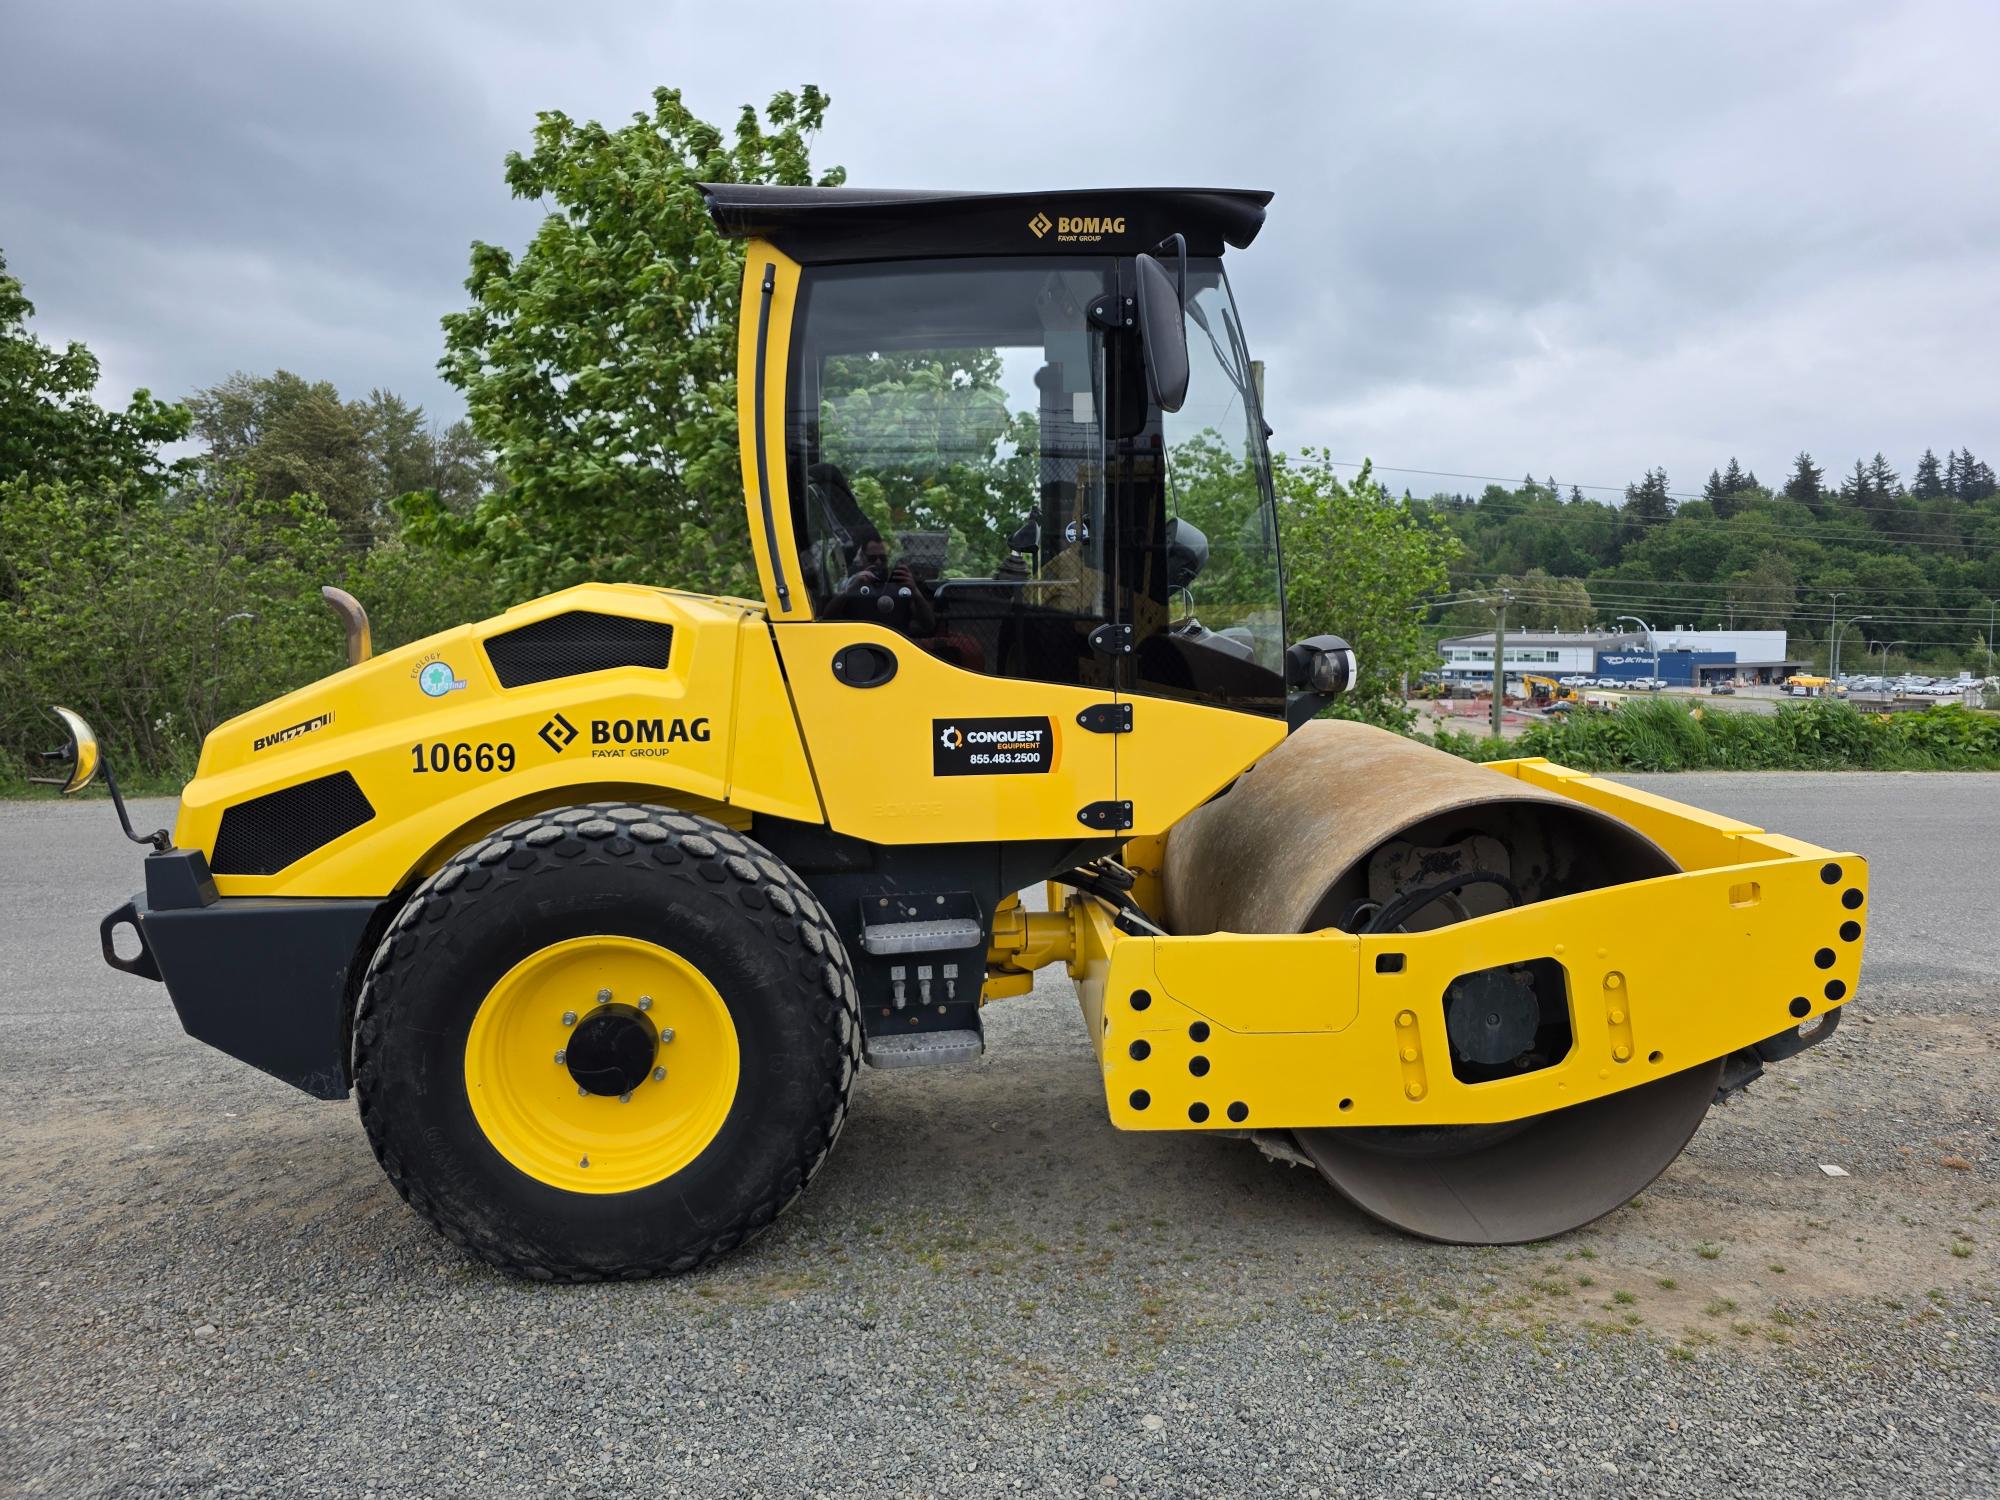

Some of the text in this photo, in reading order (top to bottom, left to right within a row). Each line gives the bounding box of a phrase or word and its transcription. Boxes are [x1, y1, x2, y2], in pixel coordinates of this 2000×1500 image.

[1058, 217, 1125, 233] BOMAG
[411, 652, 441, 679] ECOLOGY
[591, 718, 711, 744] BOMAG
[967, 730, 1043, 743] CONQUEST
[592, 748, 669, 758] FAYAT GROUP
[997, 742, 1040, 750] EQUIPMENT
[411, 742, 516, 773] 10669
[970, 753, 1040, 764] 855.483.2500
